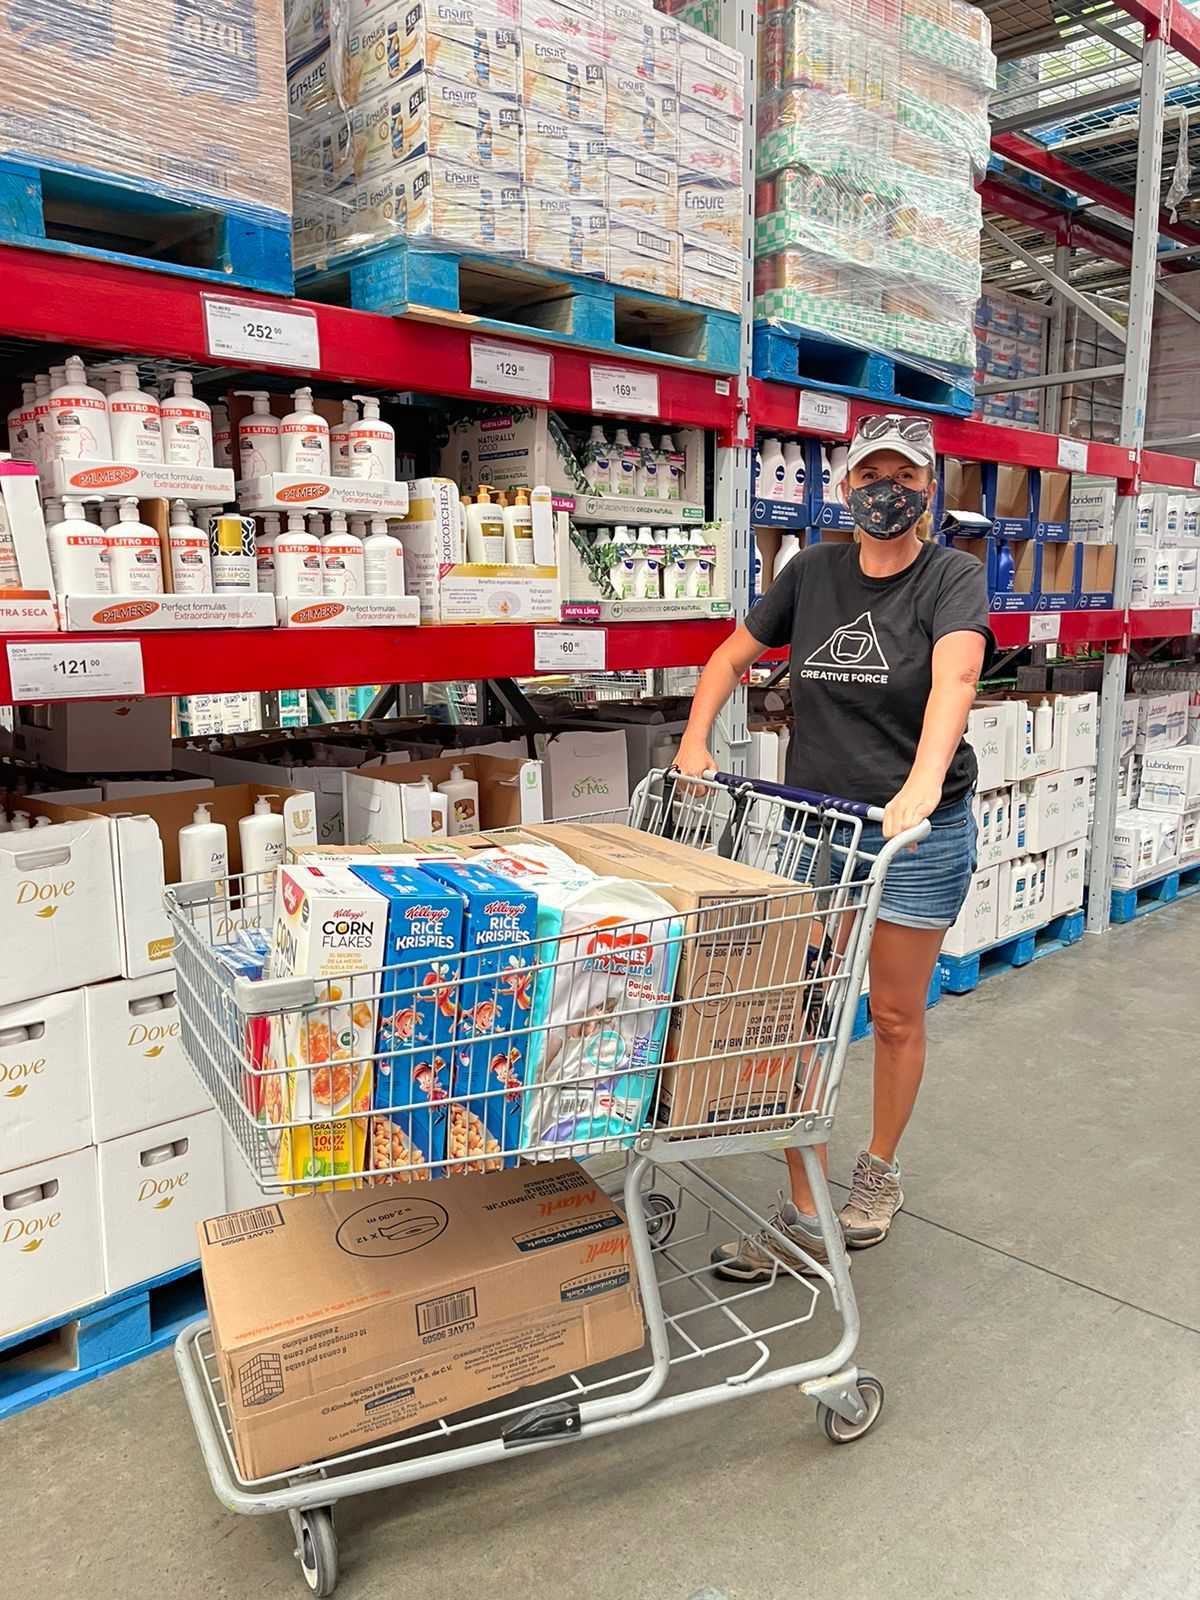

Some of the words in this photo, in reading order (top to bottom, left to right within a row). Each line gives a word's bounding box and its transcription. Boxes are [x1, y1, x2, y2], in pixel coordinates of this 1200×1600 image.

[438, 5, 473, 20] Ensure
[535, 44, 567, 59] Ensure
[289, 62, 327, 104] Ensure
[442, 87, 477, 101] Ensure
[685, 191, 724, 209] Ensure
[80, 399, 104, 408] LITRO
[120, 404, 146, 412] LITRO
[479, 432, 516, 443] NATURALLY
[79, 470, 130, 484] PALMER'S
[141, 471, 169, 480] Perfect
[153, 481, 204, 491] Extraordinary
[440, 483, 451, 563] GOICOECHEA
[102, 603, 151, 622] PALMER'S
[161, 602, 191, 612] Perfect
[174, 612, 226, 621] Extraordinary
[356, 613, 395, 621] Extraordinary
[53, 660, 88, 674] $121
[800, 670, 849, 682] CREATIVE
[851, 674, 888, 684] FORCE
[1146, 760, 1184, 771] Lubriderm
[16, 879, 75, 905] Dove
[406, 905, 449, 923] Kellogg's
[485, 900, 526, 918] Kellogg's
[216, 915, 261, 937] Dove
[322, 921, 373, 935] CORN
[411, 922, 443, 935] RICE
[490, 917, 520, 930] RICE
[322, 936, 372, 948] FLAKES
[396, 935, 454, 951] KRISPIES
[476, 930, 530, 944] KRISPIES
[128, 1021, 180, 1046] Dove
[314, 1135, 344, 1146] 100%
[138, 1171, 189, 1202] Dove
[2, 1212, 62, 1242] Dove
[246, 1229, 274, 1240] CLAVE
[356, 1236, 368, 1244] 12
[526, 1222, 603, 1248] Kimberly-Clark
[566, 1278, 618, 1298] Kimberly-Clark
[447, 1321, 475, 1338] CLAVE
[318, 1329, 358, 1348] corrugados
[283, 1348, 303, 1361] cama
[305, 1342, 317, 1354] por
[306, 1353, 318, 1364] por
[285, 1361, 305, 1372] estiba
[350, 1386, 373, 1398] HECHO
[374, 1382, 384, 1390] EN
